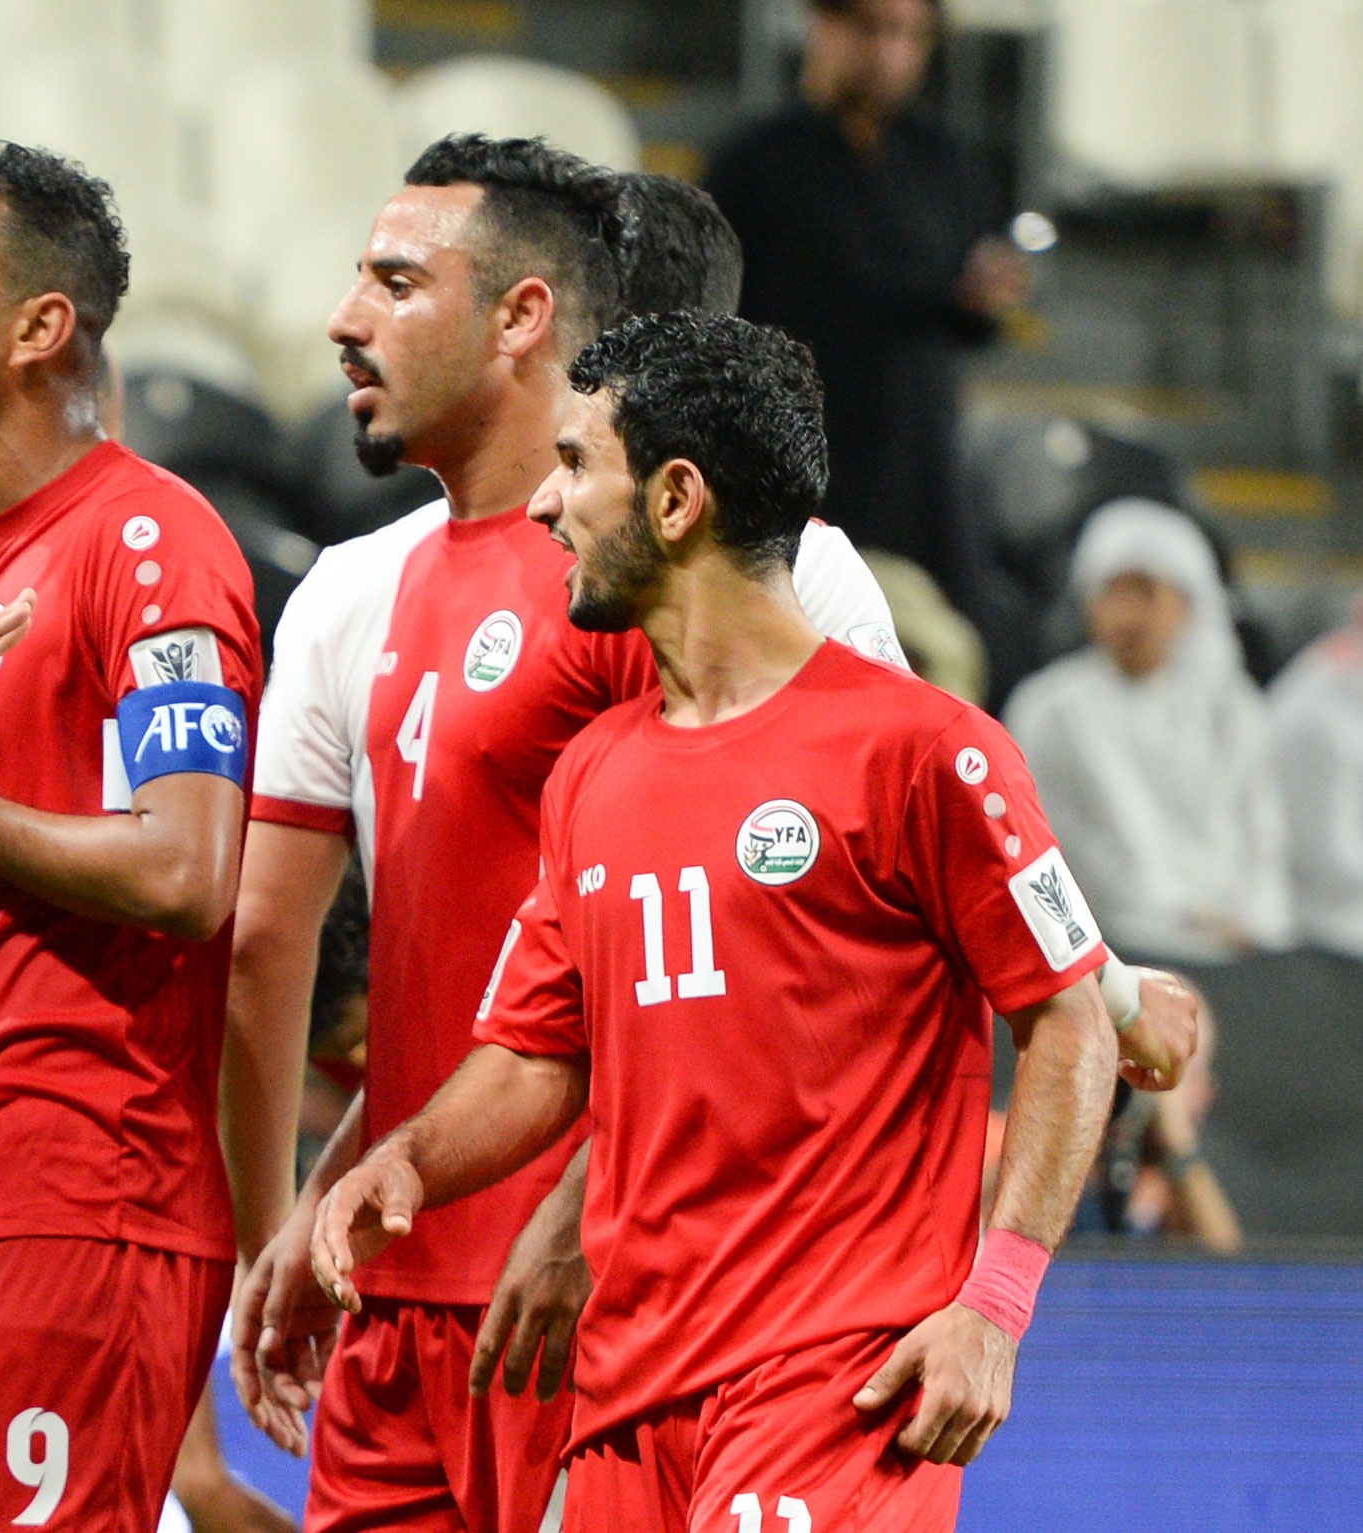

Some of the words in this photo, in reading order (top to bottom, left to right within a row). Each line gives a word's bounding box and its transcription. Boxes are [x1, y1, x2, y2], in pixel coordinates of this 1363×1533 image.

[134, 702, 242, 763] AFC
[395, 671, 439, 801] 4
[775, 826, 806, 843] YFA
[630, 865, 727, 1007] 11
[6, 1406, 70, 1526] 9
